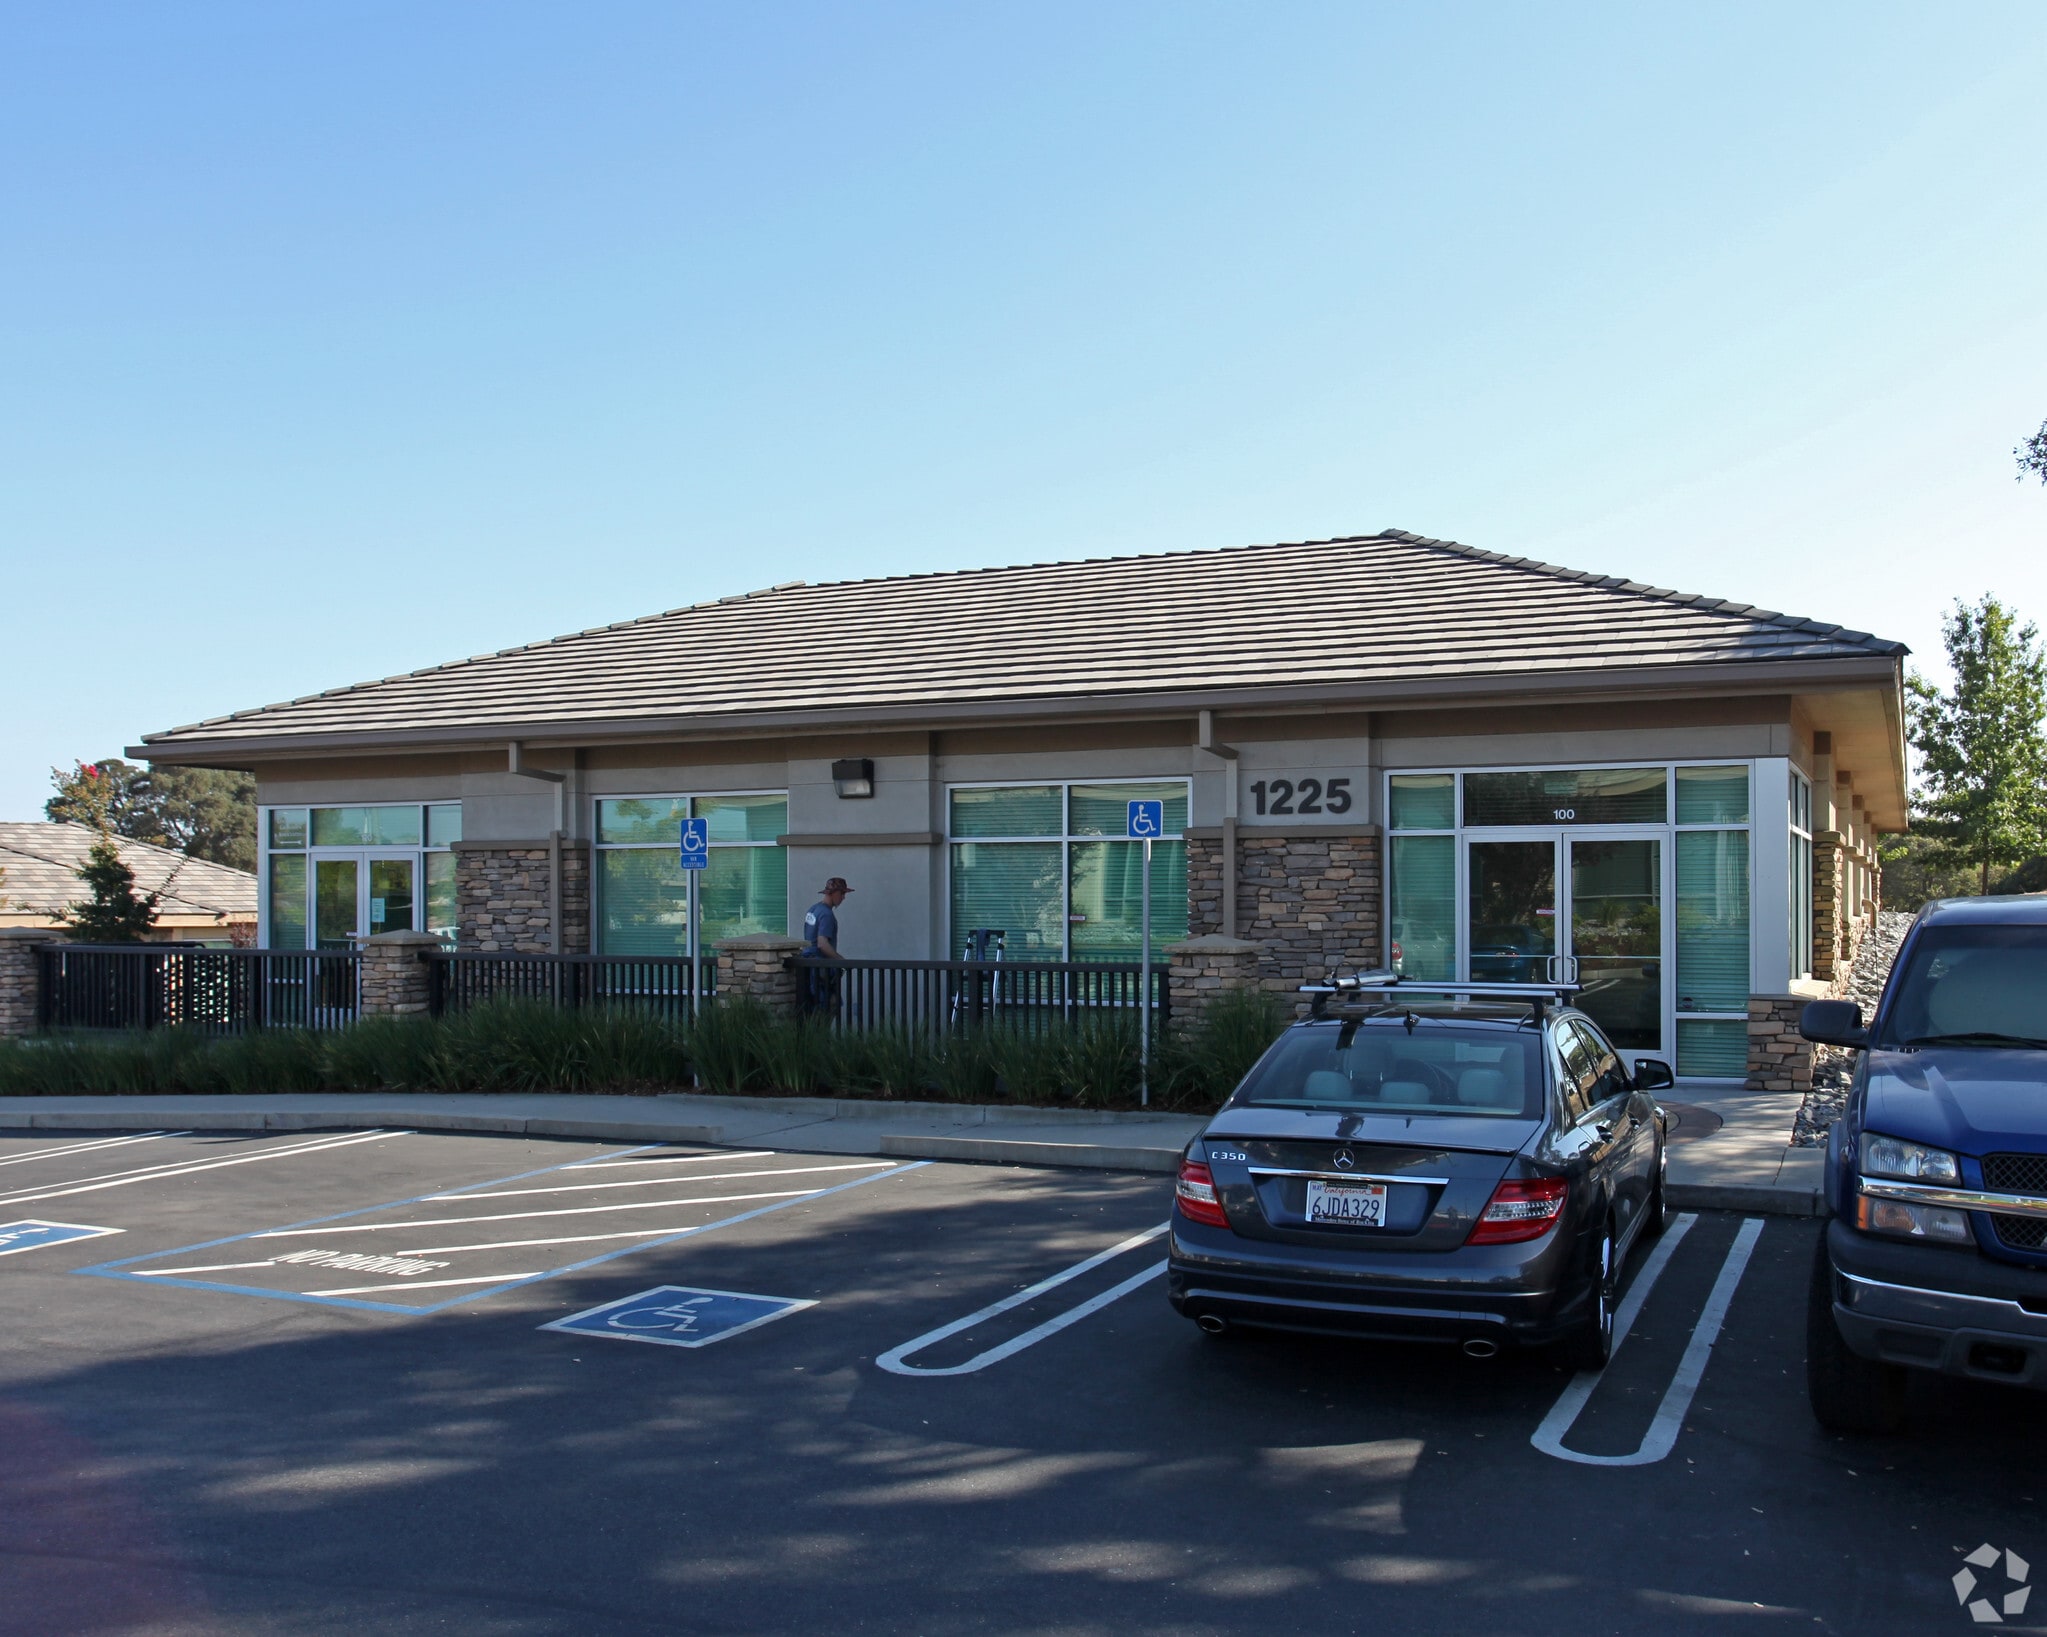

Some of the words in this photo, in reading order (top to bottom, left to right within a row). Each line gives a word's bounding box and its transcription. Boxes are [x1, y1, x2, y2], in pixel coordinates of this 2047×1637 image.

[1250, 778, 1352, 815] 1225
[1553, 809, 1575, 820] 100
[1324, 1187, 1369, 1196] California
[1312, 1196, 1380, 1219] 6JDA329
[267, 1249, 340, 1263] NO
[309, 1253, 451, 1276] PARKING
